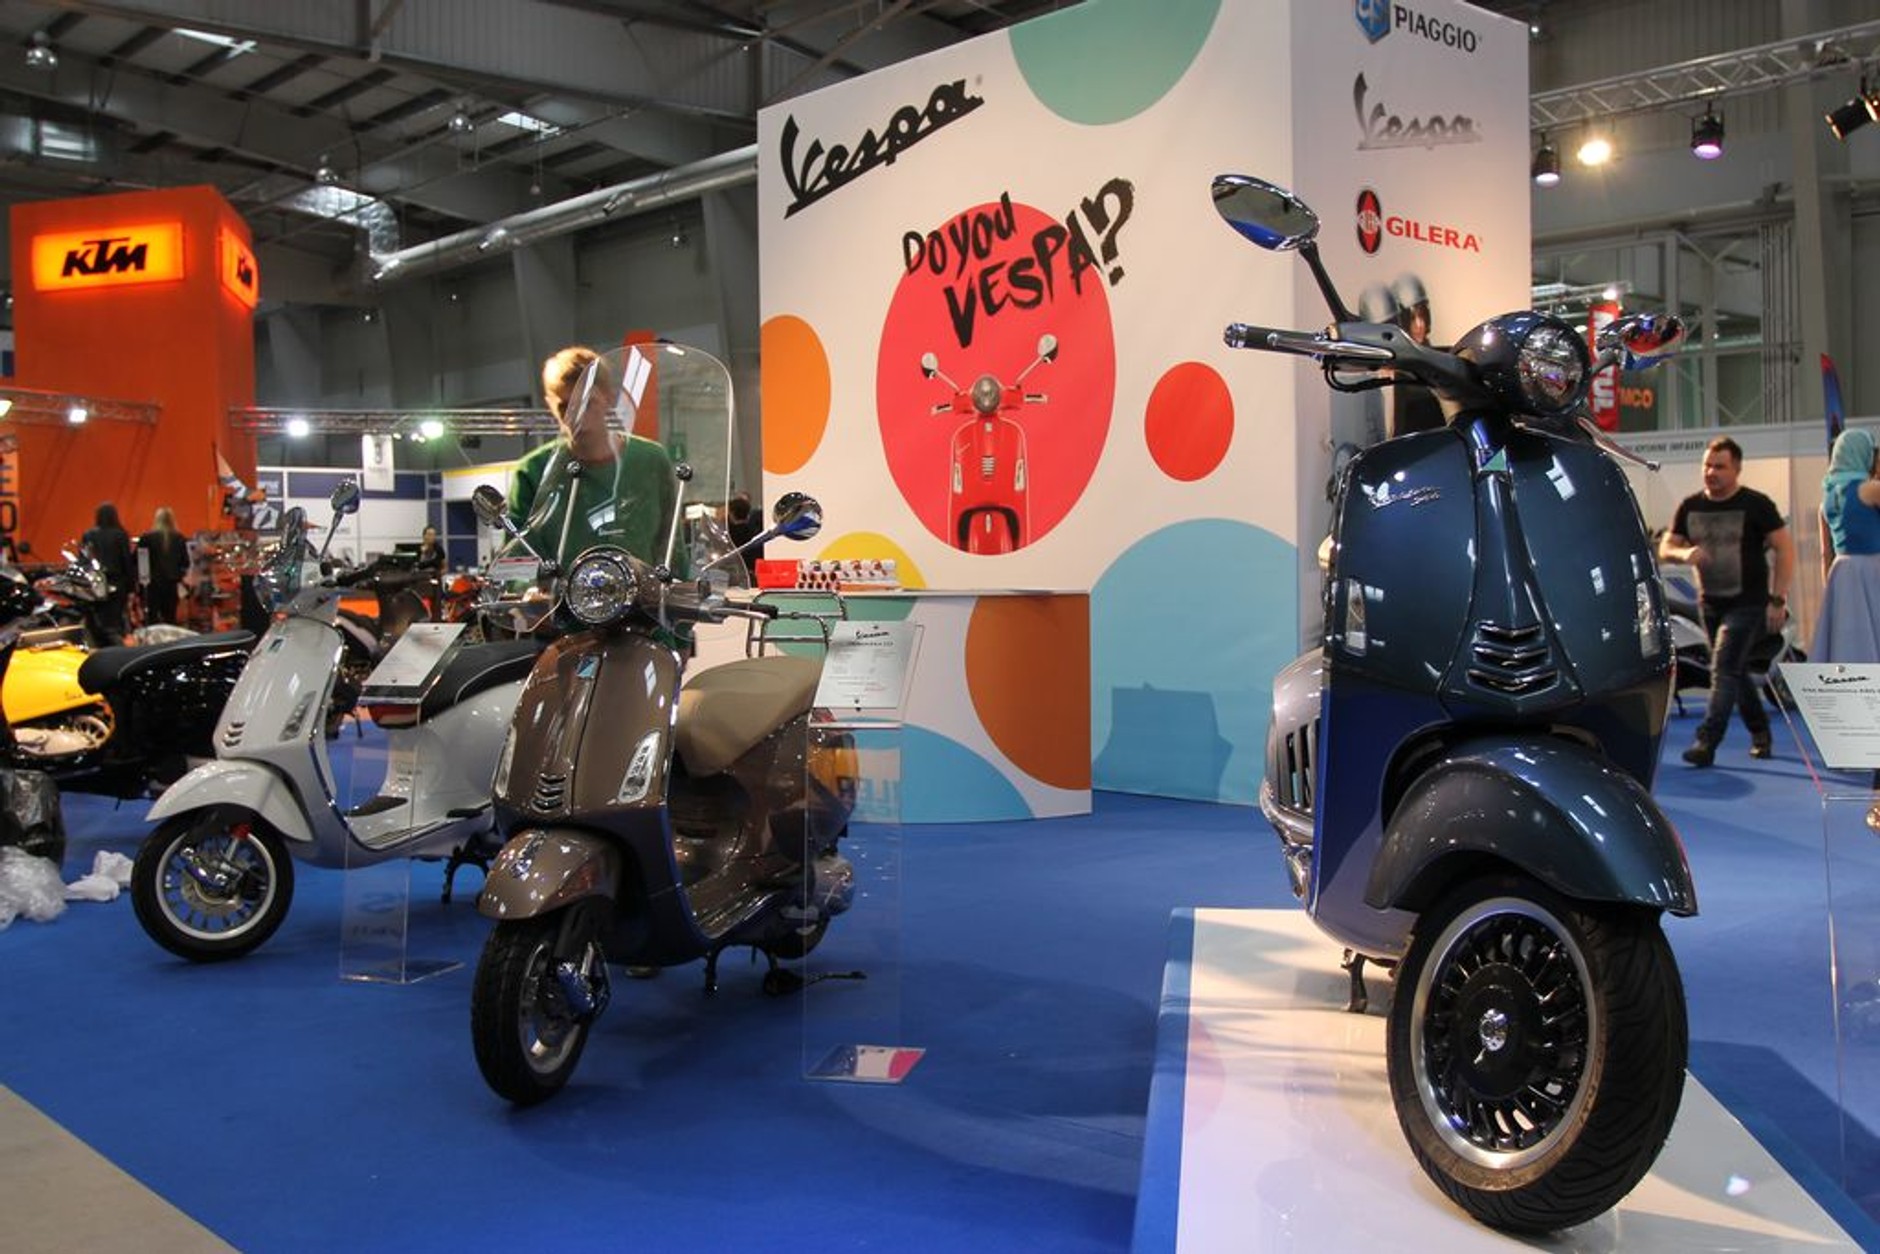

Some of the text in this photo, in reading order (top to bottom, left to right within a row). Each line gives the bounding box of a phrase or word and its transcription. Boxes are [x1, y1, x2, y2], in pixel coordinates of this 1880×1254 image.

[1394, 5, 1476, 53] PIAGGIO
[1353, 71, 1482, 150] Vespa
[780, 79, 985, 219] Vespa
[61, 236, 149, 278] KTM
[1386, 216, 1480, 253] GILERA
